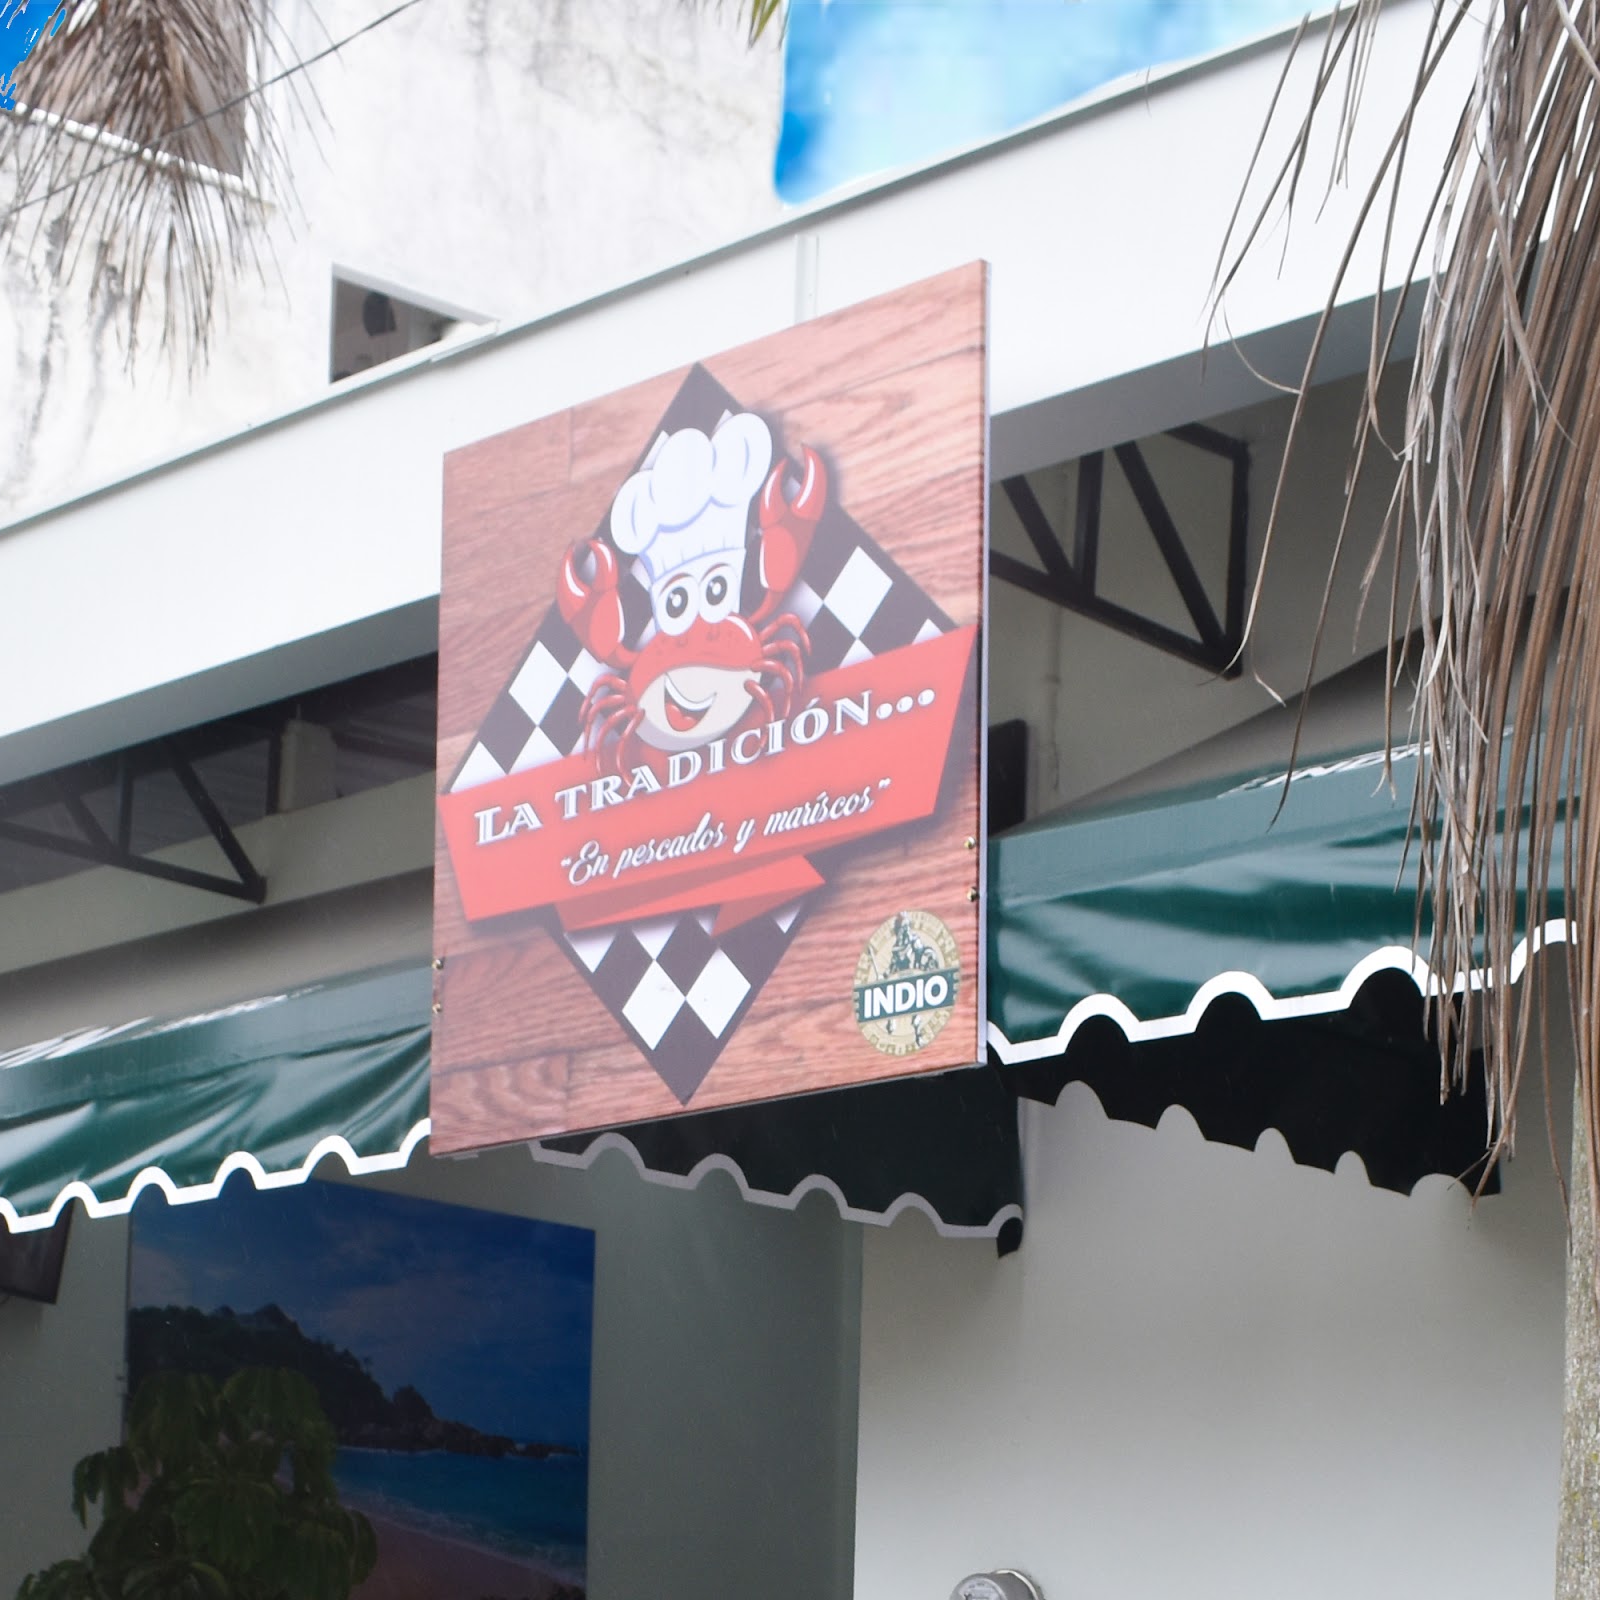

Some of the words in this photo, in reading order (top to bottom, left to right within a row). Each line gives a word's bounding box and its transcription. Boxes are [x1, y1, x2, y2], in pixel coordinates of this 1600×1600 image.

[475, 804, 543, 845] LA
[613, 811, 728, 879] pescados
[732, 818, 756, 854] y
[863, 974, 949, 1019] INDIO
